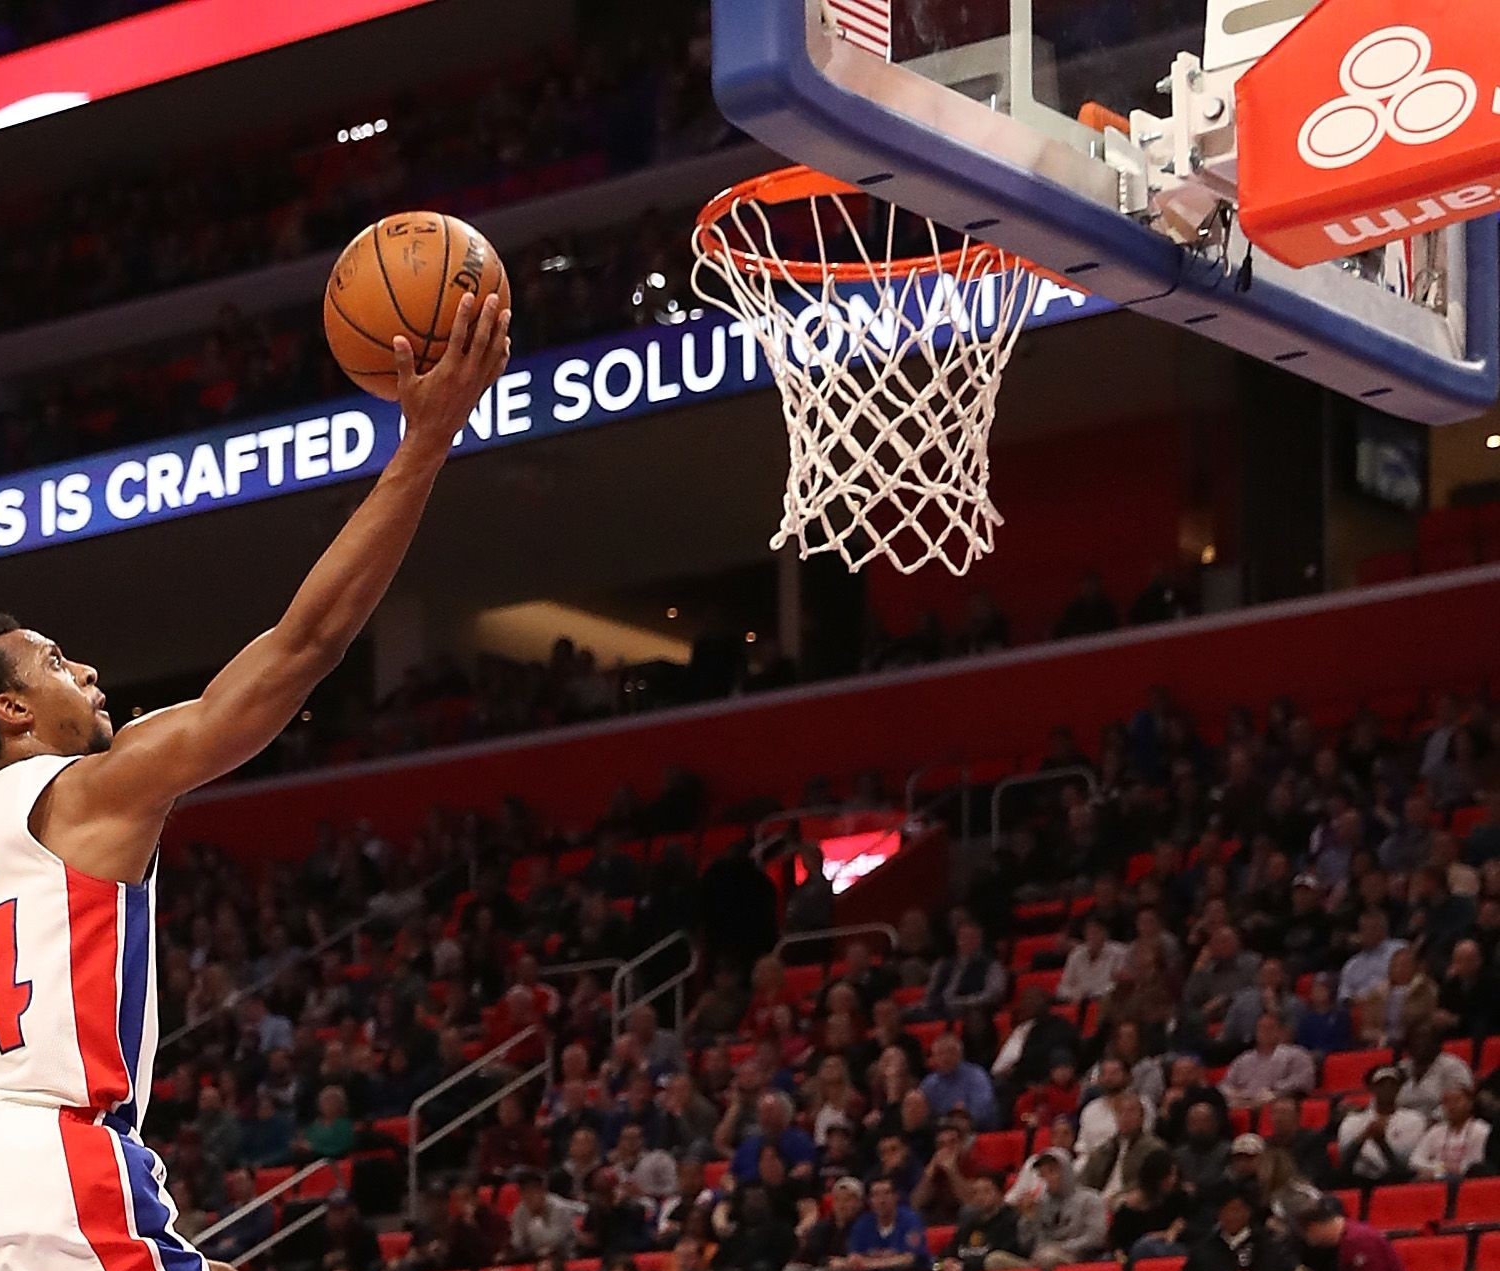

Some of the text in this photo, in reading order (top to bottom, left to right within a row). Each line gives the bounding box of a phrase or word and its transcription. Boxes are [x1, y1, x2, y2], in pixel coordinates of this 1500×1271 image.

[1323, 183, 1500, 247] arm
[40, 473, 93, 537] IS
[105, 409, 376, 521] CRAFTED
[399, 370, 532, 447] NE
